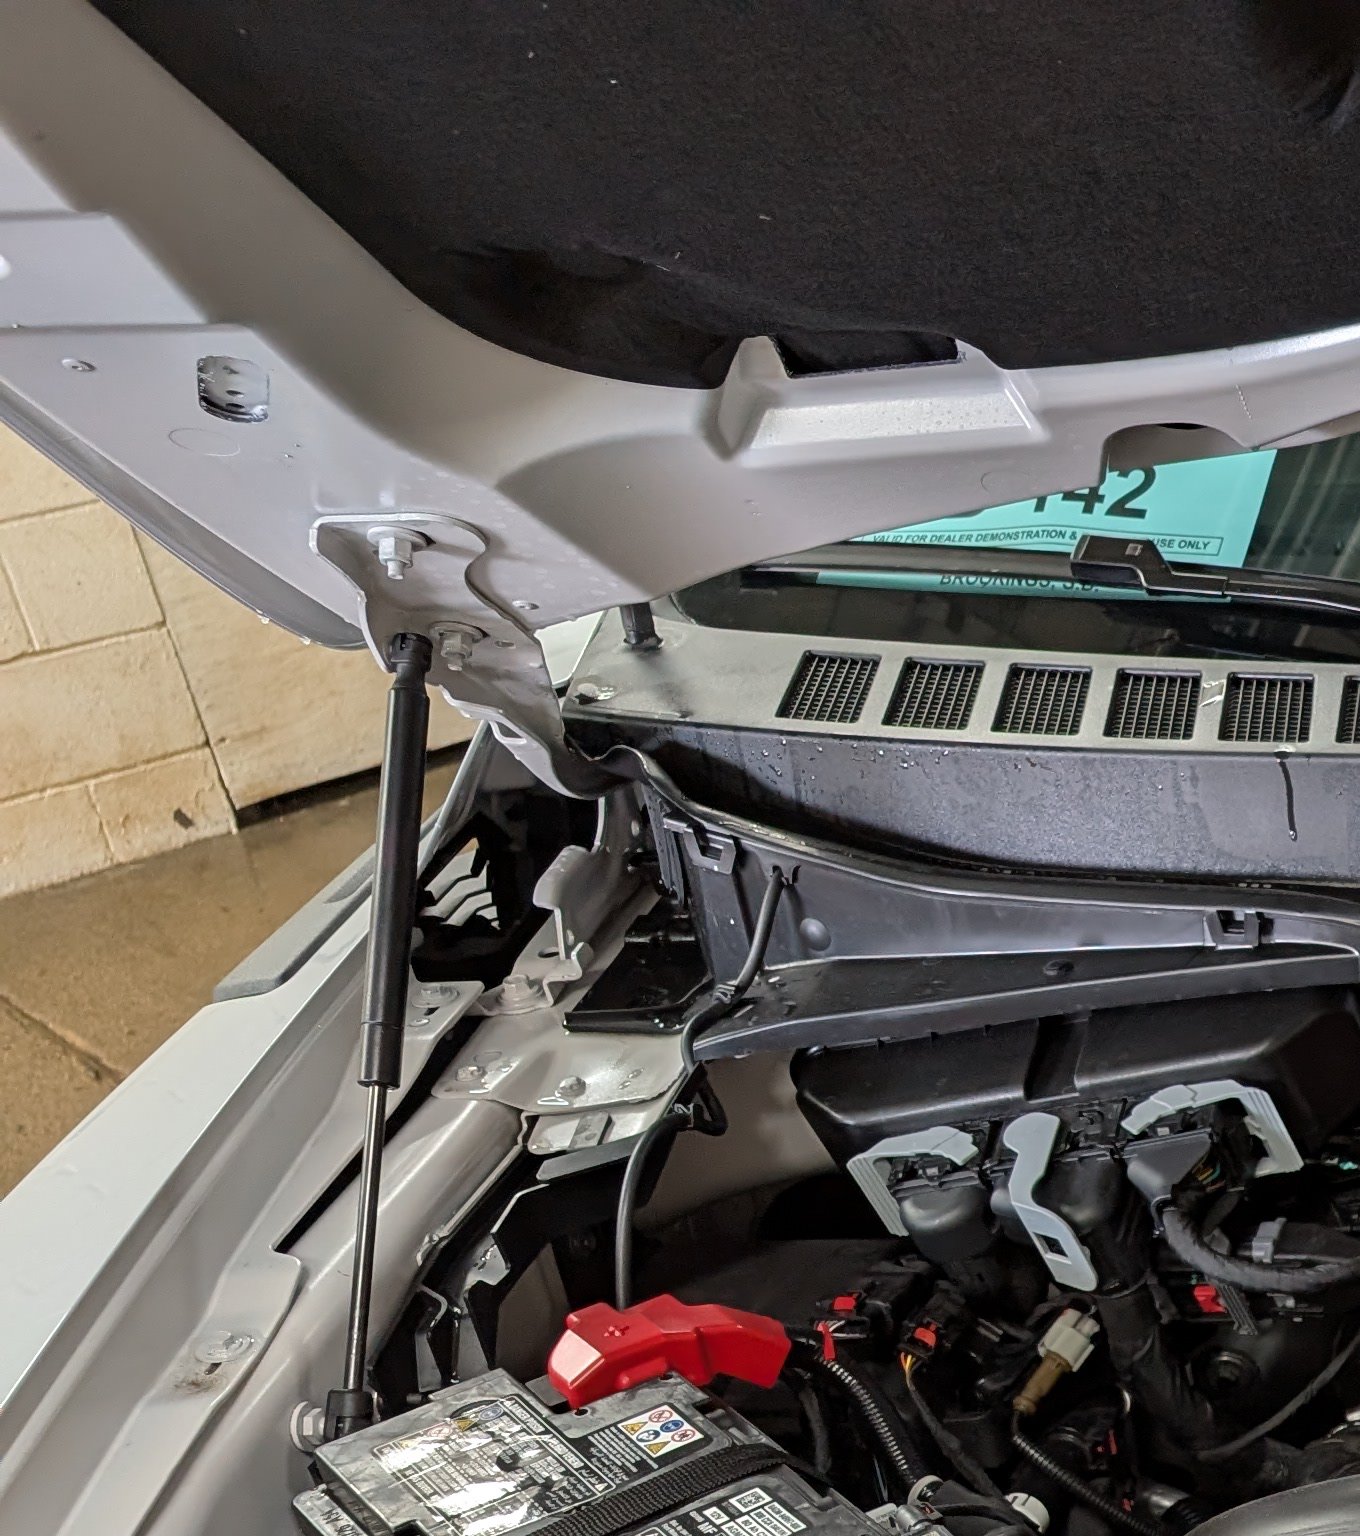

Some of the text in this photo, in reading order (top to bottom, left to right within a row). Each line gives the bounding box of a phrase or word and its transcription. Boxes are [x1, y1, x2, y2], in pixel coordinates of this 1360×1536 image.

[905, 535, 928, 543] FOR
[929, 534, 972, 543] DEALER
[975, 529, 1067, 543] DEMONSTRATION
[1070, 531, 1077, 540] &
[1178, 539, 1210, 550] ONLY
